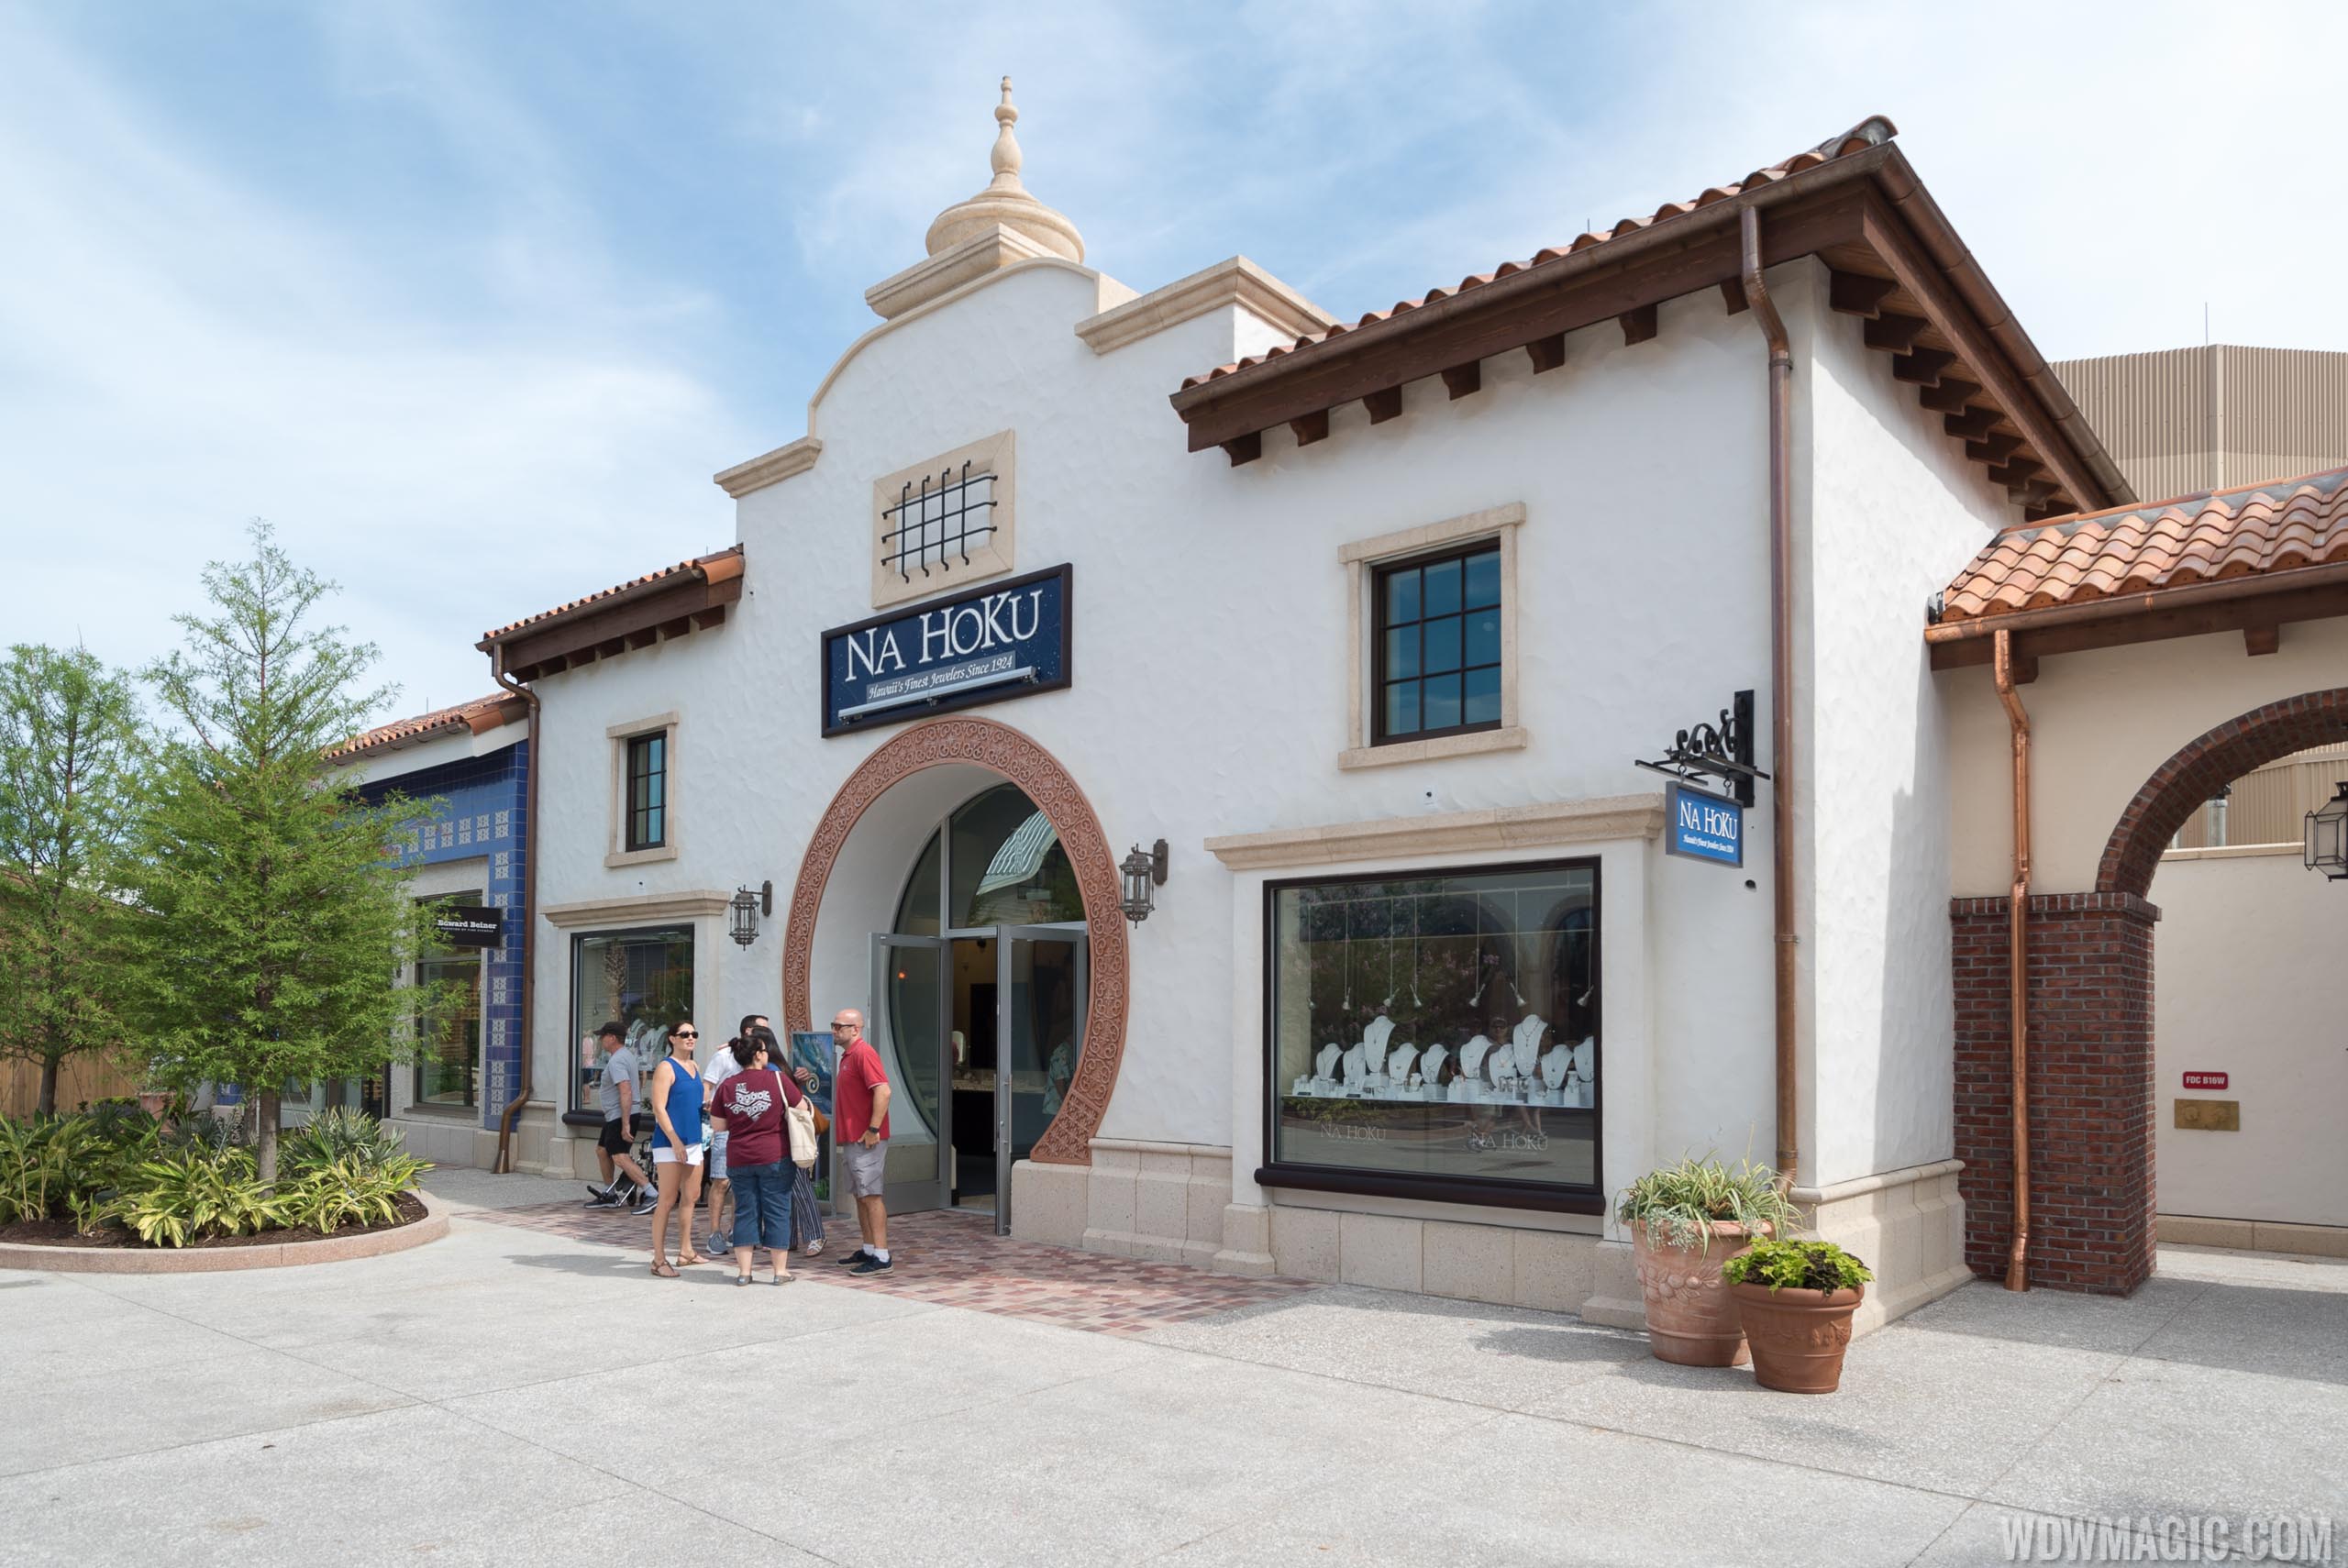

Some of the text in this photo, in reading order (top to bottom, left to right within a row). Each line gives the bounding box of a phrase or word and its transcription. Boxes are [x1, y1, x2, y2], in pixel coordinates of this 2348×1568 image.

[845, 590, 1043, 681] NA HOKU
[869, 655, 1013, 699] Hawaii's Finest Jewelers Since 1924
[1680, 800, 1738, 840] NA HOKU
[437, 919, 469, 928] Edward
[470, 922, 498, 930] Beiner
[2186, 1076, 2201, 1085] FDC
[1321, 1123, 1342, 1138] NA
[1346, 1125, 1386, 1142] HOKU
[1471, 1132, 1548, 1151] NA HOKU
